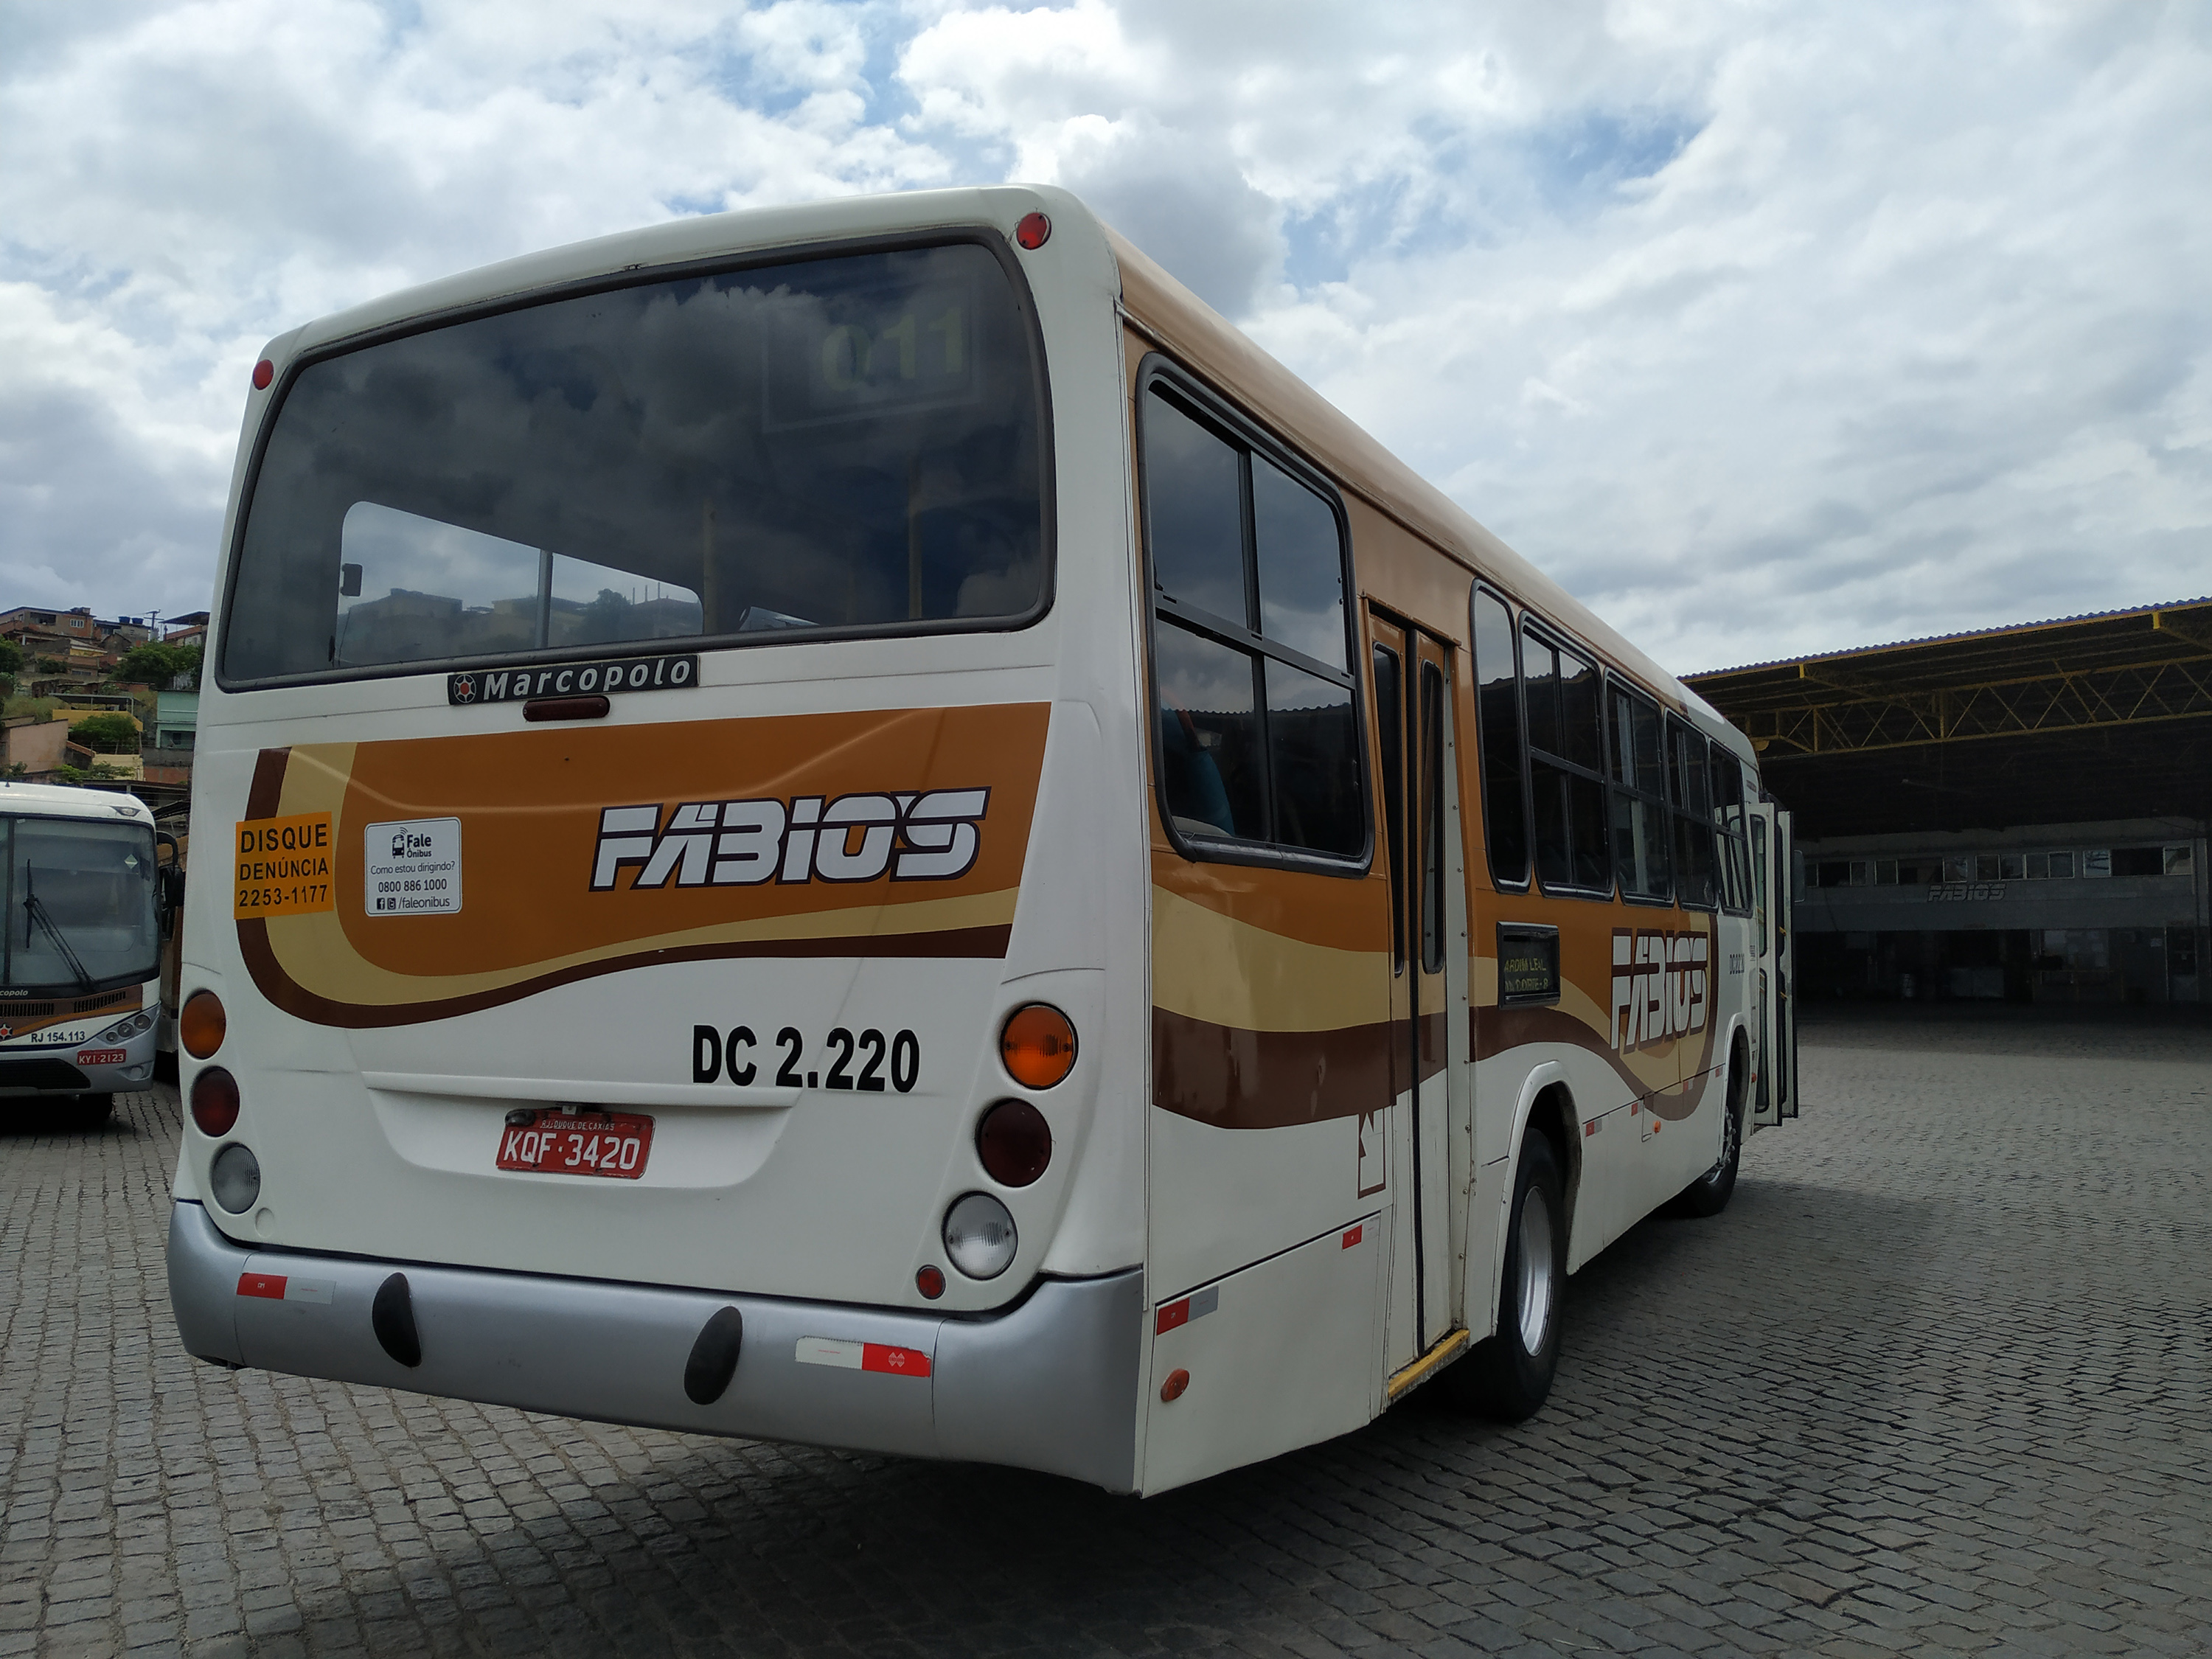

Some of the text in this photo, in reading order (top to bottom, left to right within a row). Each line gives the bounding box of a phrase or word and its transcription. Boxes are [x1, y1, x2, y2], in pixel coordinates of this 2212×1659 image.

[822, 308, 963, 392] 011
[483, 658, 691, 701] Marcopolo
[240, 823, 327, 853] DISQUE
[406, 833, 432, 848] Fale
[406, 848, 432, 858] Ônibus
[240, 856, 329, 880] DENÚNCIA
[370, 860, 456, 874] Como estou dirigindo?
[378, 878, 448, 893] 0800 886 1000
[239, 884, 327, 907] 2253-1177
[398, 896, 451, 909] /faleonibus
[31, 1031, 85, 1043] RJ 154.113
[693, 1025, 920, 1093] DC 2.220
